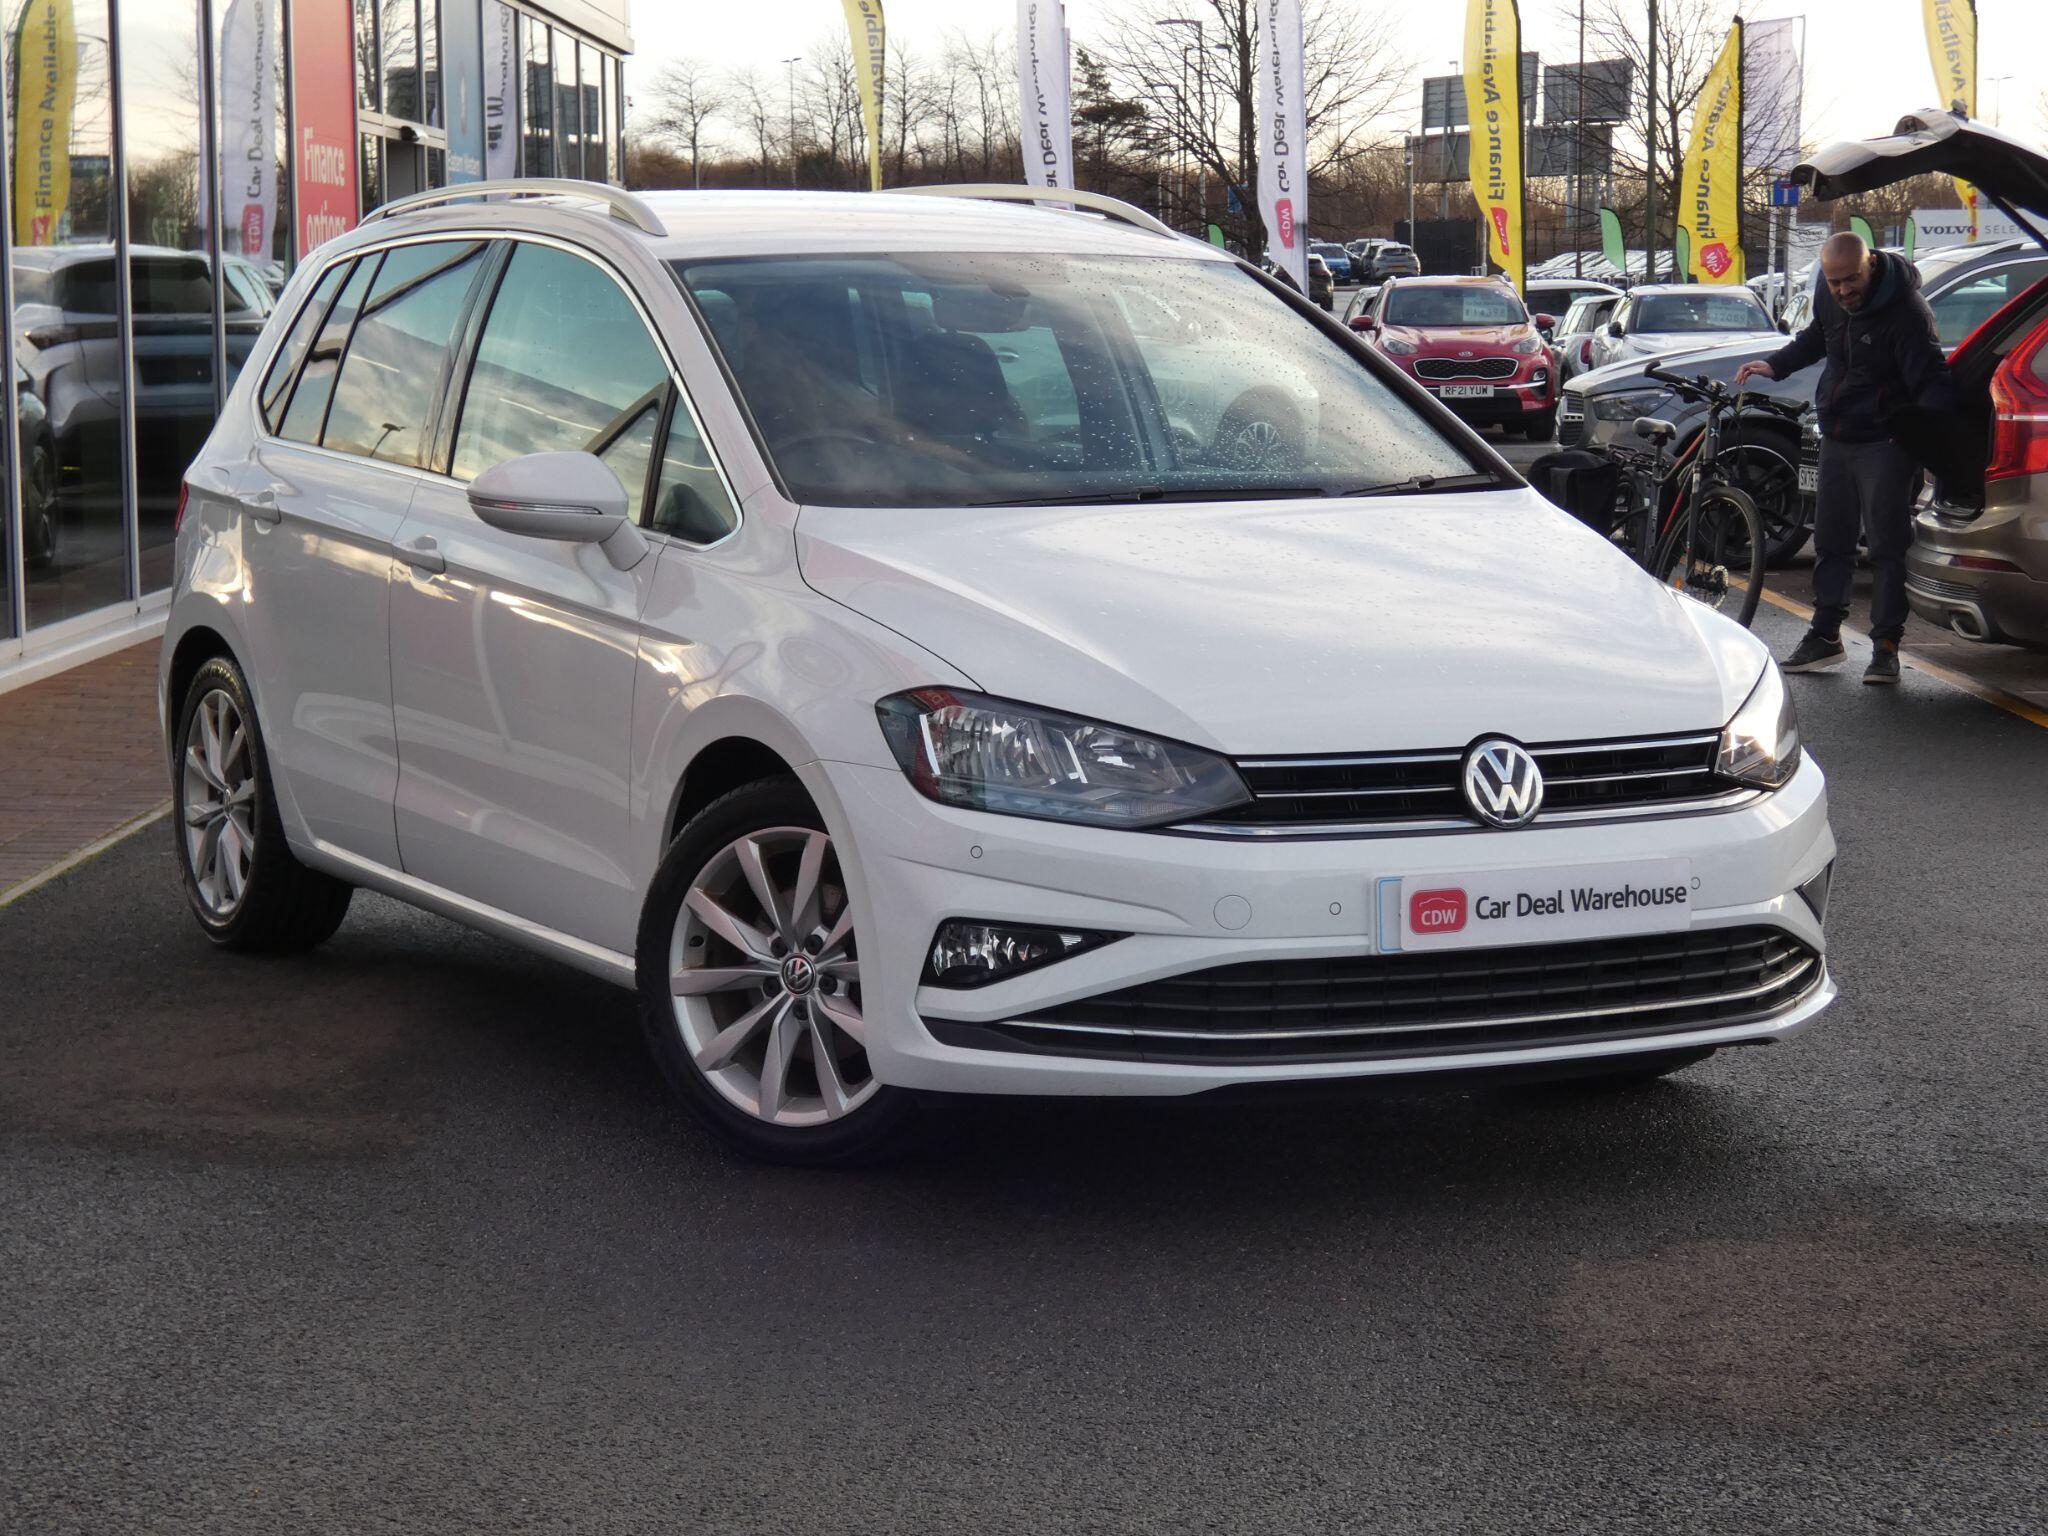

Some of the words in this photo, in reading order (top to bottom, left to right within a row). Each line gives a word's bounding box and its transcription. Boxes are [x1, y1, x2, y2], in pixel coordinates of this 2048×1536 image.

[38, 4, 57, 112] Available
[251, 1, 265, 111] Warehouse
[247, 117, 264, 160] Deal
[303, 126, 346, 187] Finance
[34, 118, 54, 209] Finance
[247, 166, 263, 198] Car
[1984, 225, 2018, 234] SELE
[1445, 386, 1467, 394] RF21
[1470, 386, 1488, 394] YUW
[1421, 908, 1457, 926] CDW
[1475, 894, 1511, 921] Car
[1516, 889, 1565, 917] Deal
[1570, 883, 1687, 913] Warehouse
